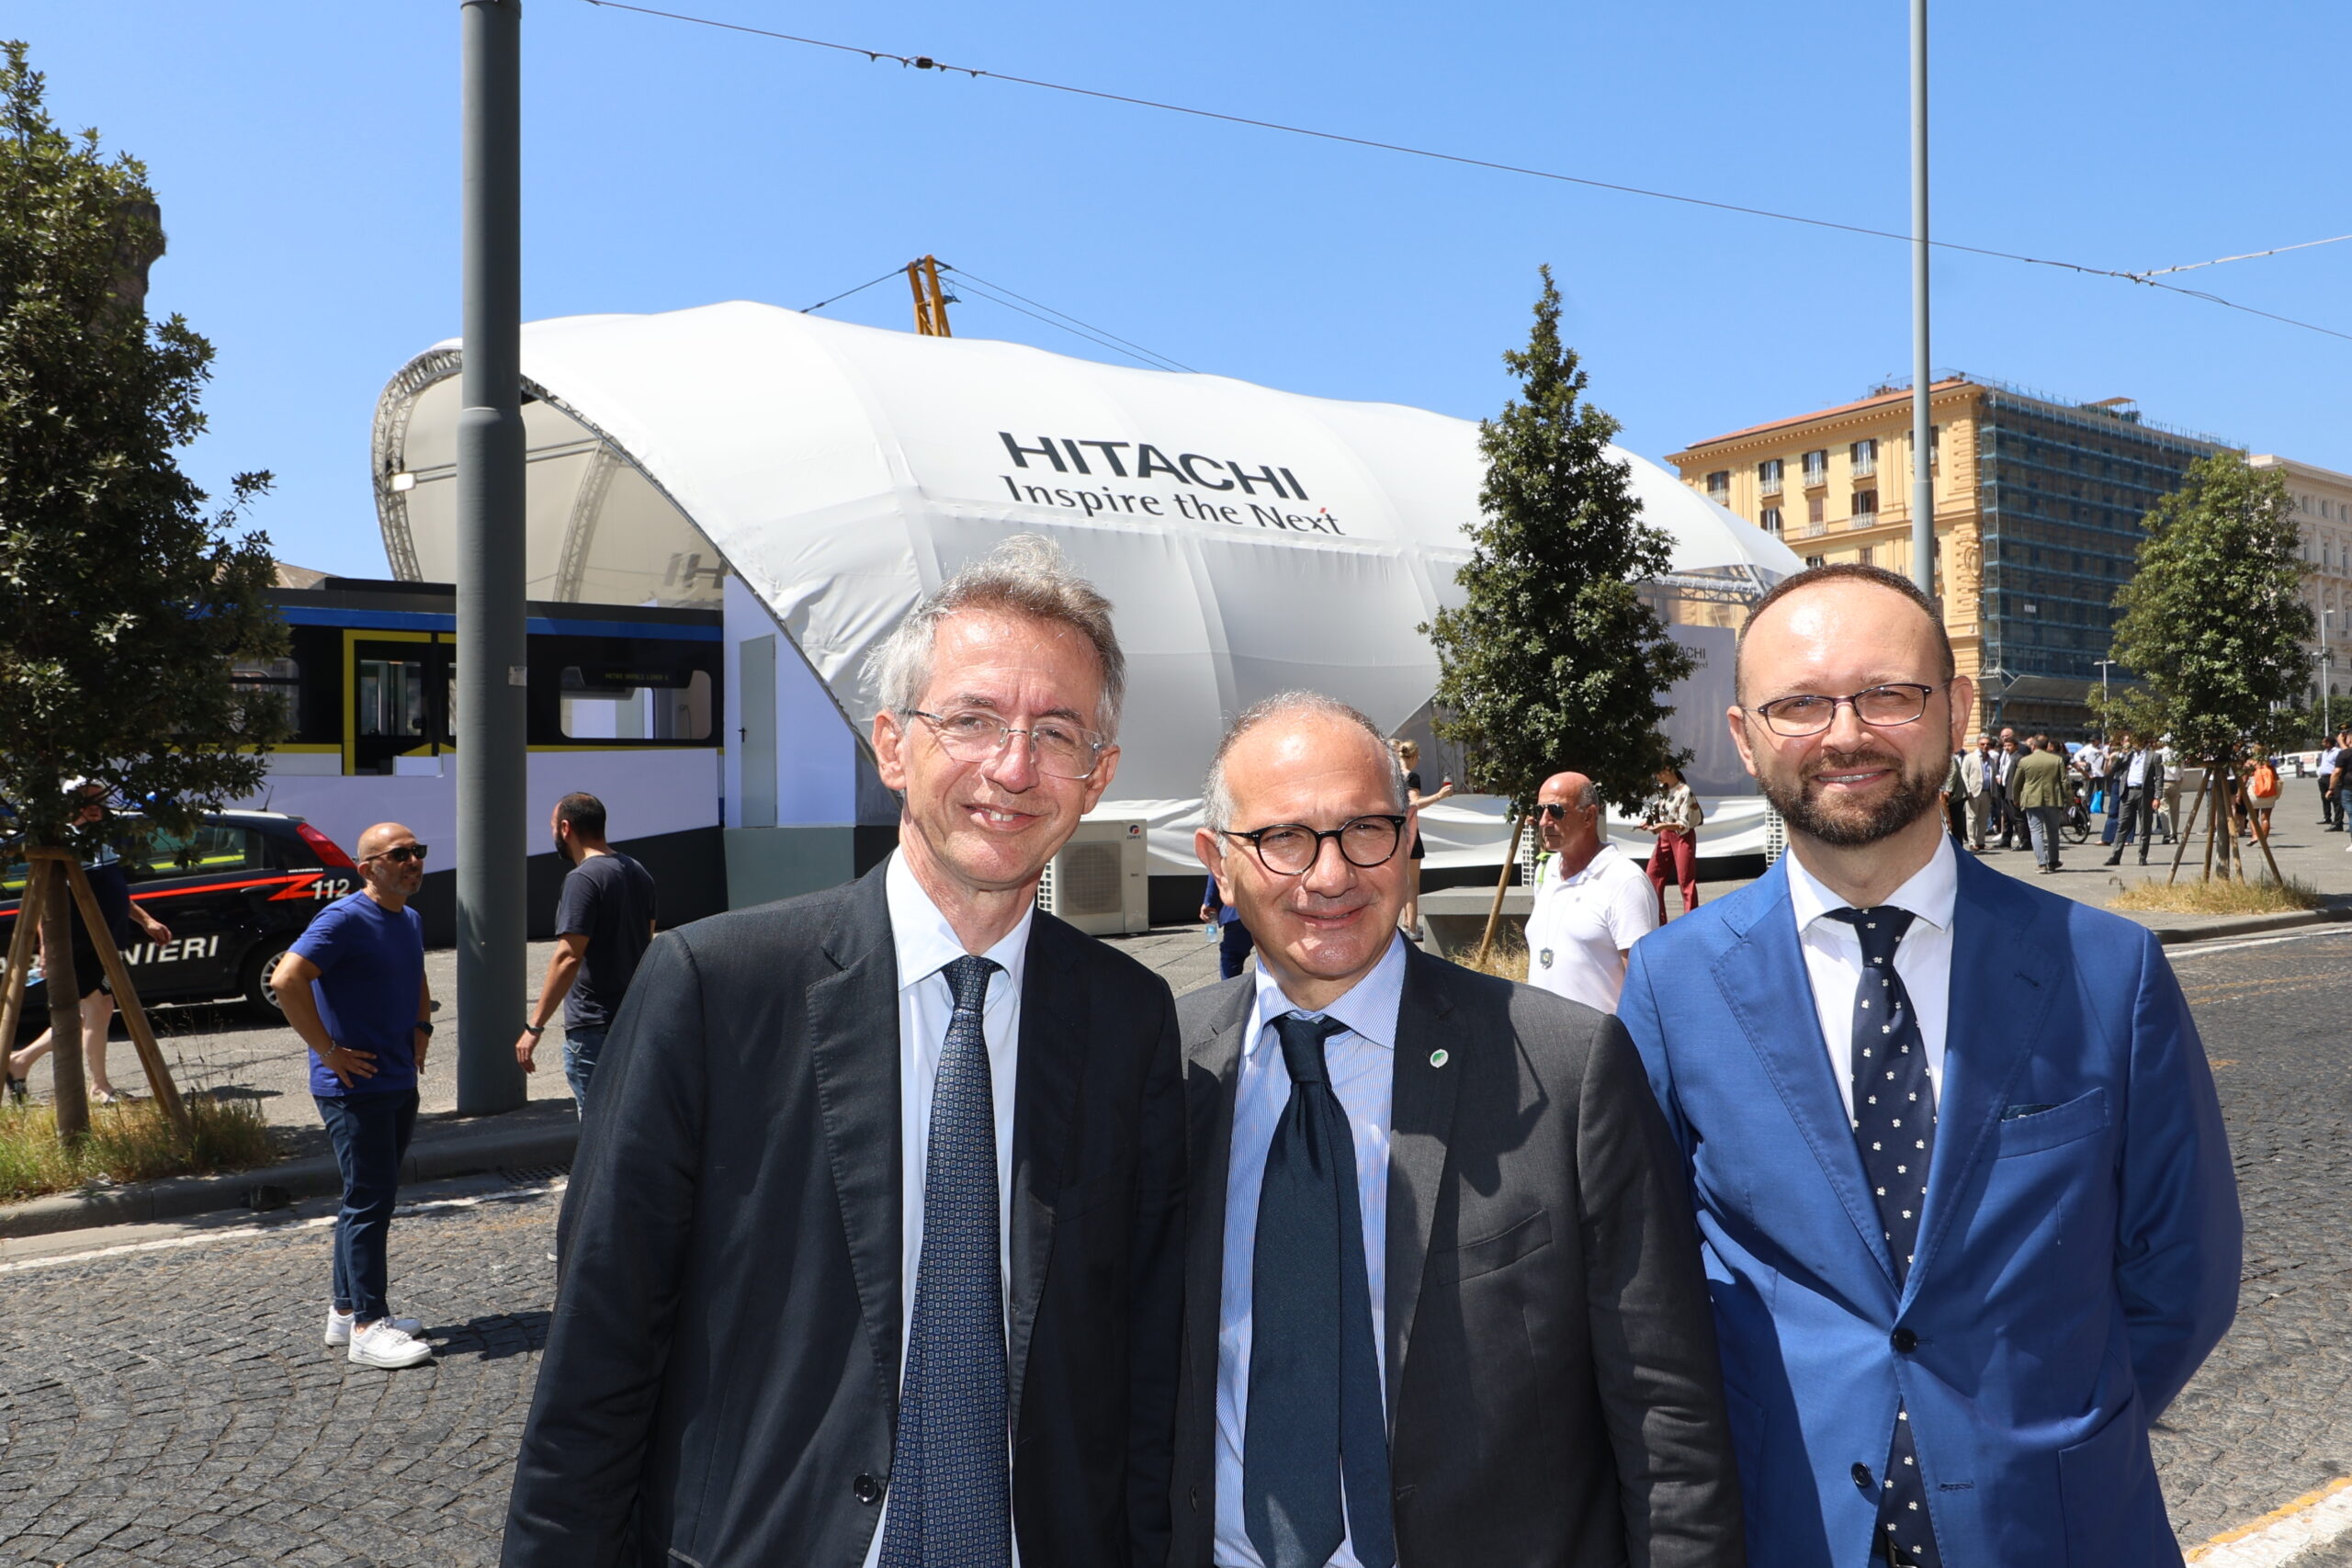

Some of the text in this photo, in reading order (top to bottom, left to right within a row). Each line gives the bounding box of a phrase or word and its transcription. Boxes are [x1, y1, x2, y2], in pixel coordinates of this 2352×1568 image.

[999, 432, 1310, 502] HITACHI
[999, 475, 1346, 536] Inspire the Next
[1678, 646, 1706, 660] ACHI
[311, 878, 350, 900] 112
